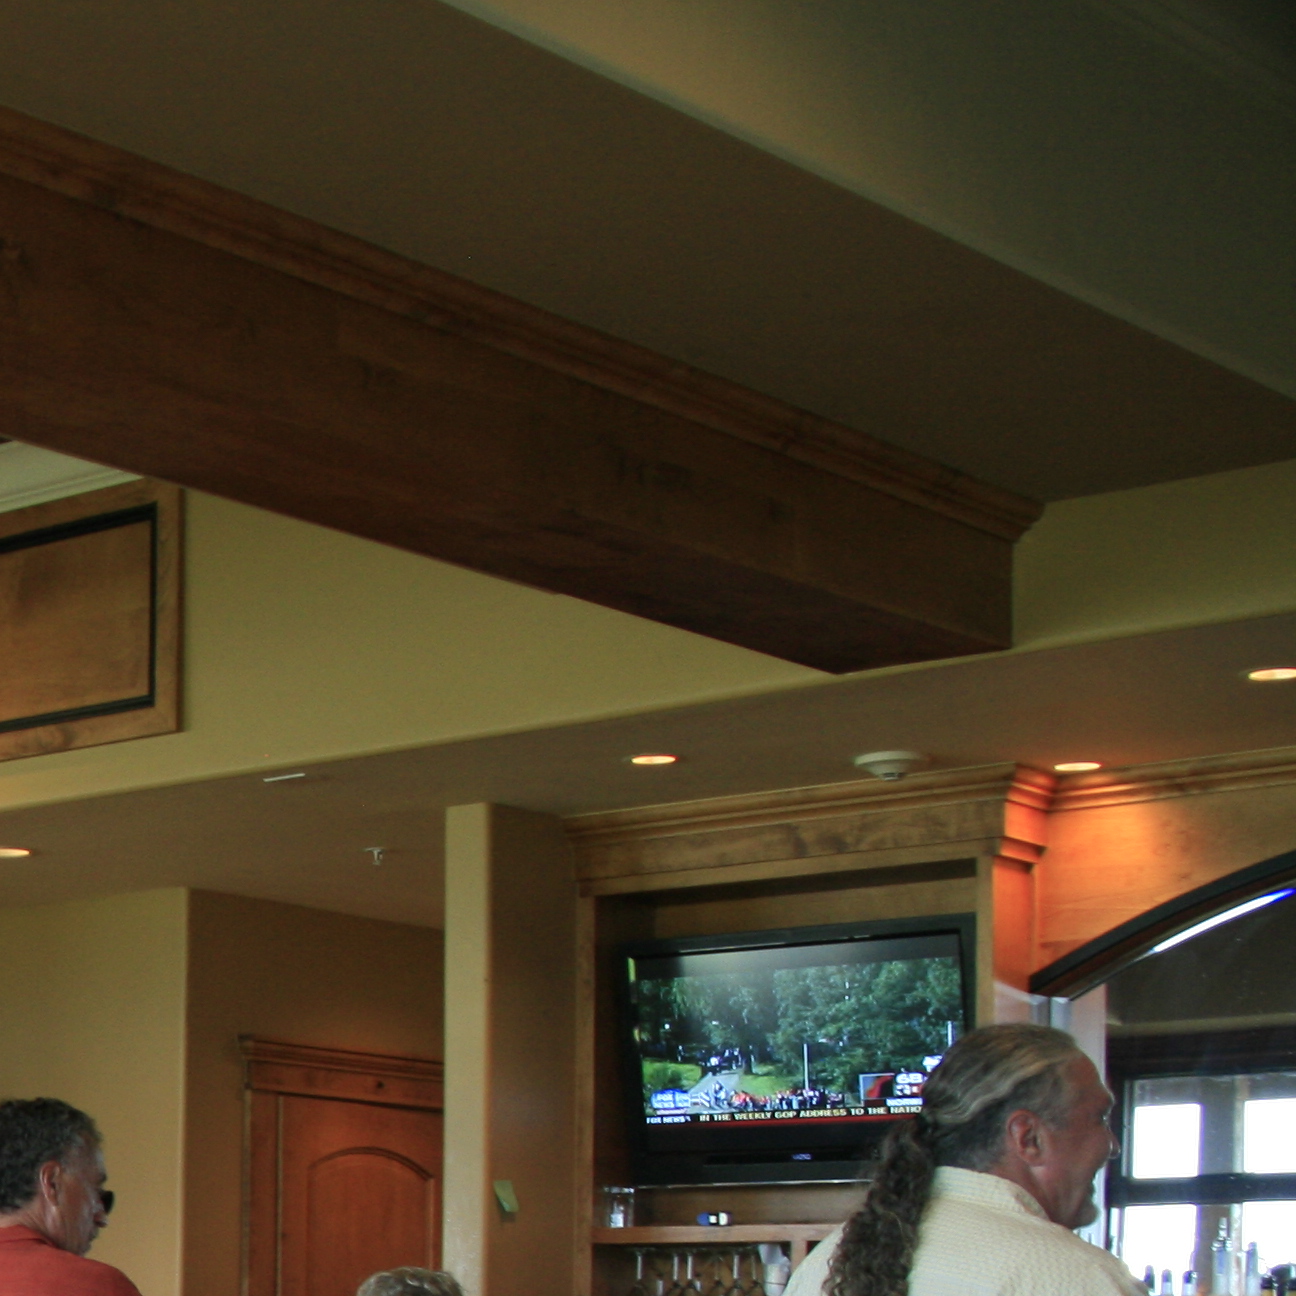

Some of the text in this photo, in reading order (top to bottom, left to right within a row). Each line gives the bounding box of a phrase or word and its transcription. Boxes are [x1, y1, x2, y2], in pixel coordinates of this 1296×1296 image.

[713, 1113, 731, 1121] THE
[734, 1111, 772, 1120] WEEKLY
[774, 1110, 797, 1119] GOP
[799, 1109, 847, 1118] ADDRESS
[850, 1108, 865, 1116] TO
[867, 1107, 888, 1115] THE
[890, 1106, 923, 1114] NATIO
